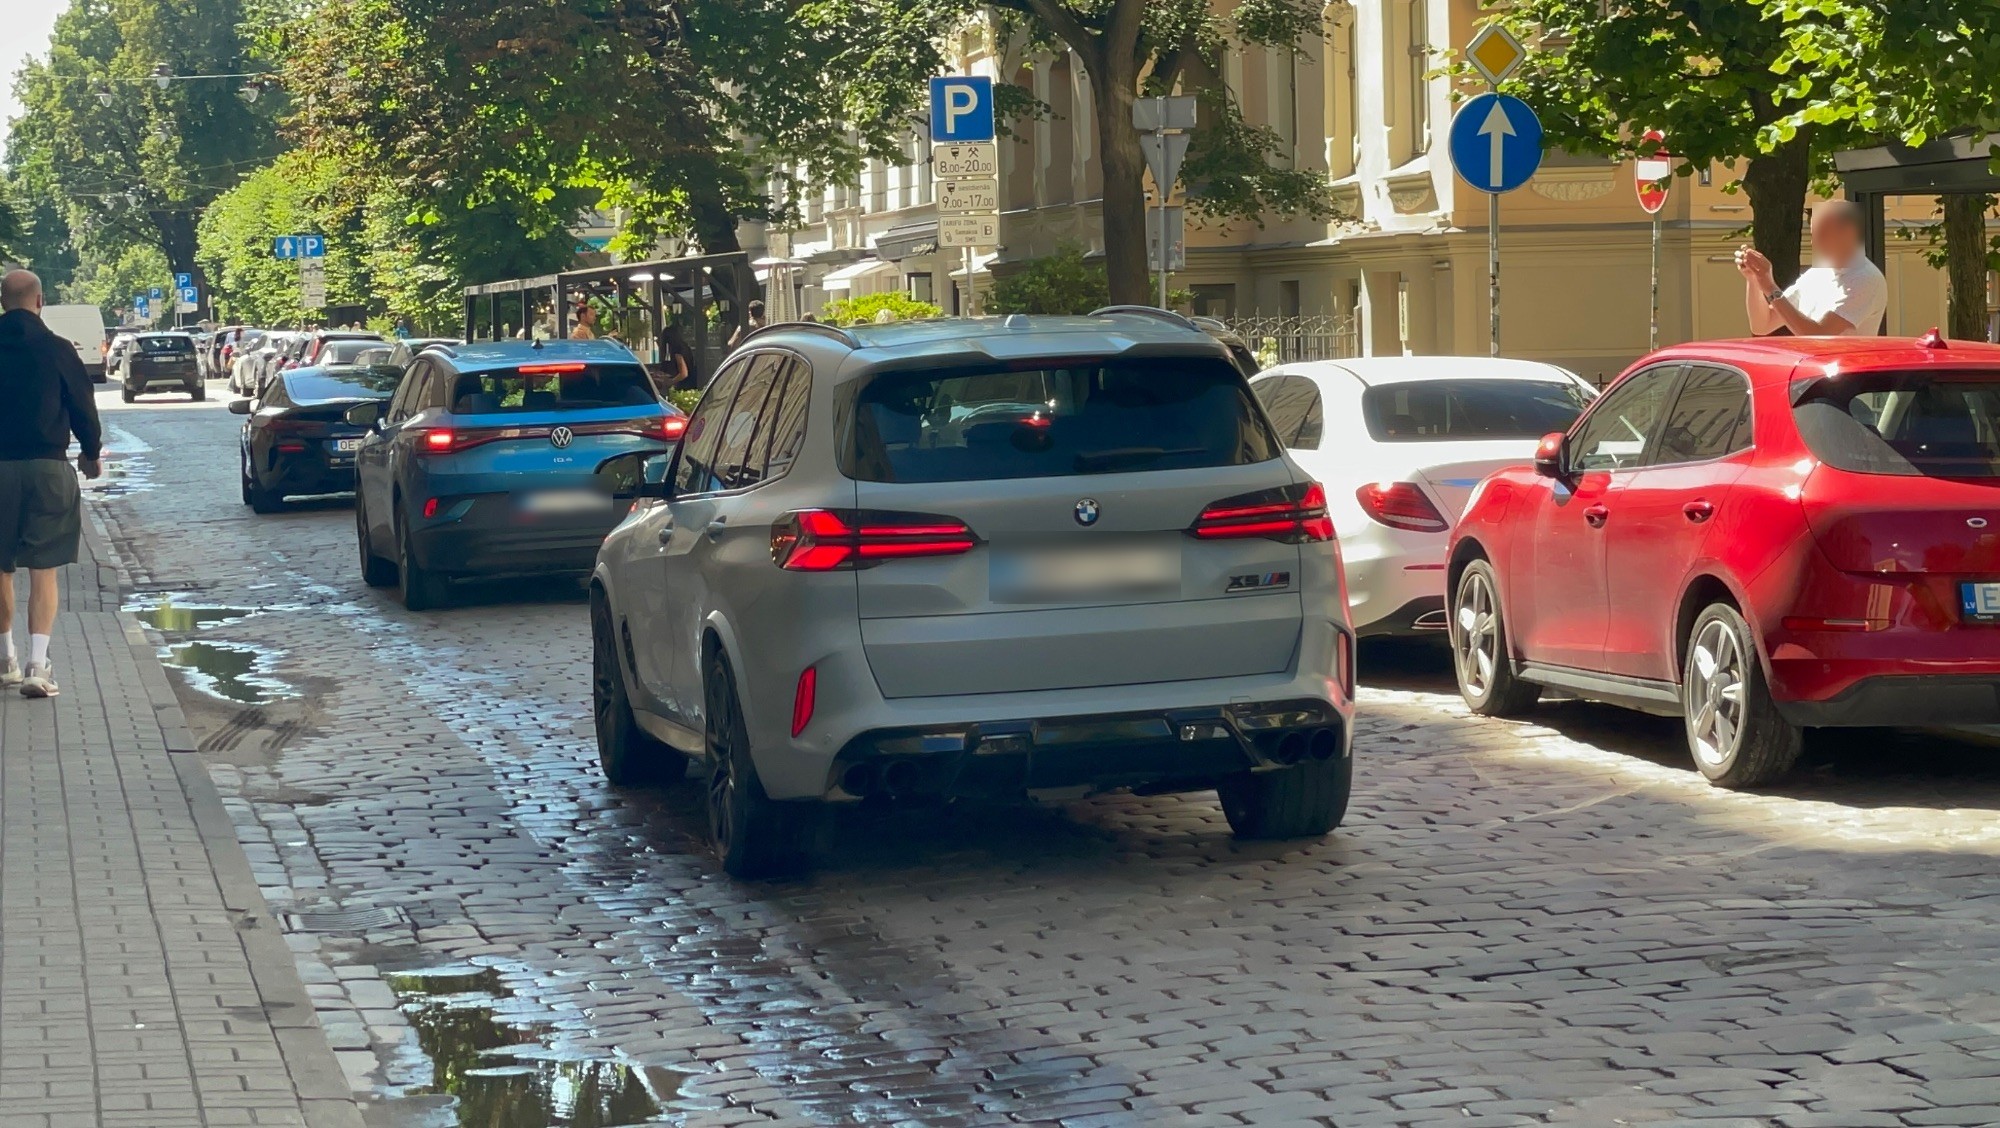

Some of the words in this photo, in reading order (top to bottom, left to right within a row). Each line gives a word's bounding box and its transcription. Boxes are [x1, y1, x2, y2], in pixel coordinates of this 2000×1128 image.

[944, 84, 978, 134] P
[984, 225, 993, 236] B
[306, 238, 318, 255] P
[179, 275, 188, 286] P
[151, 288, 159, 298] P
[184, 289, 193, 301] P
[136, 296, 144, 306] P
[142, 307, 149, 317] P
[1965, 601, 1976, 609] LV
